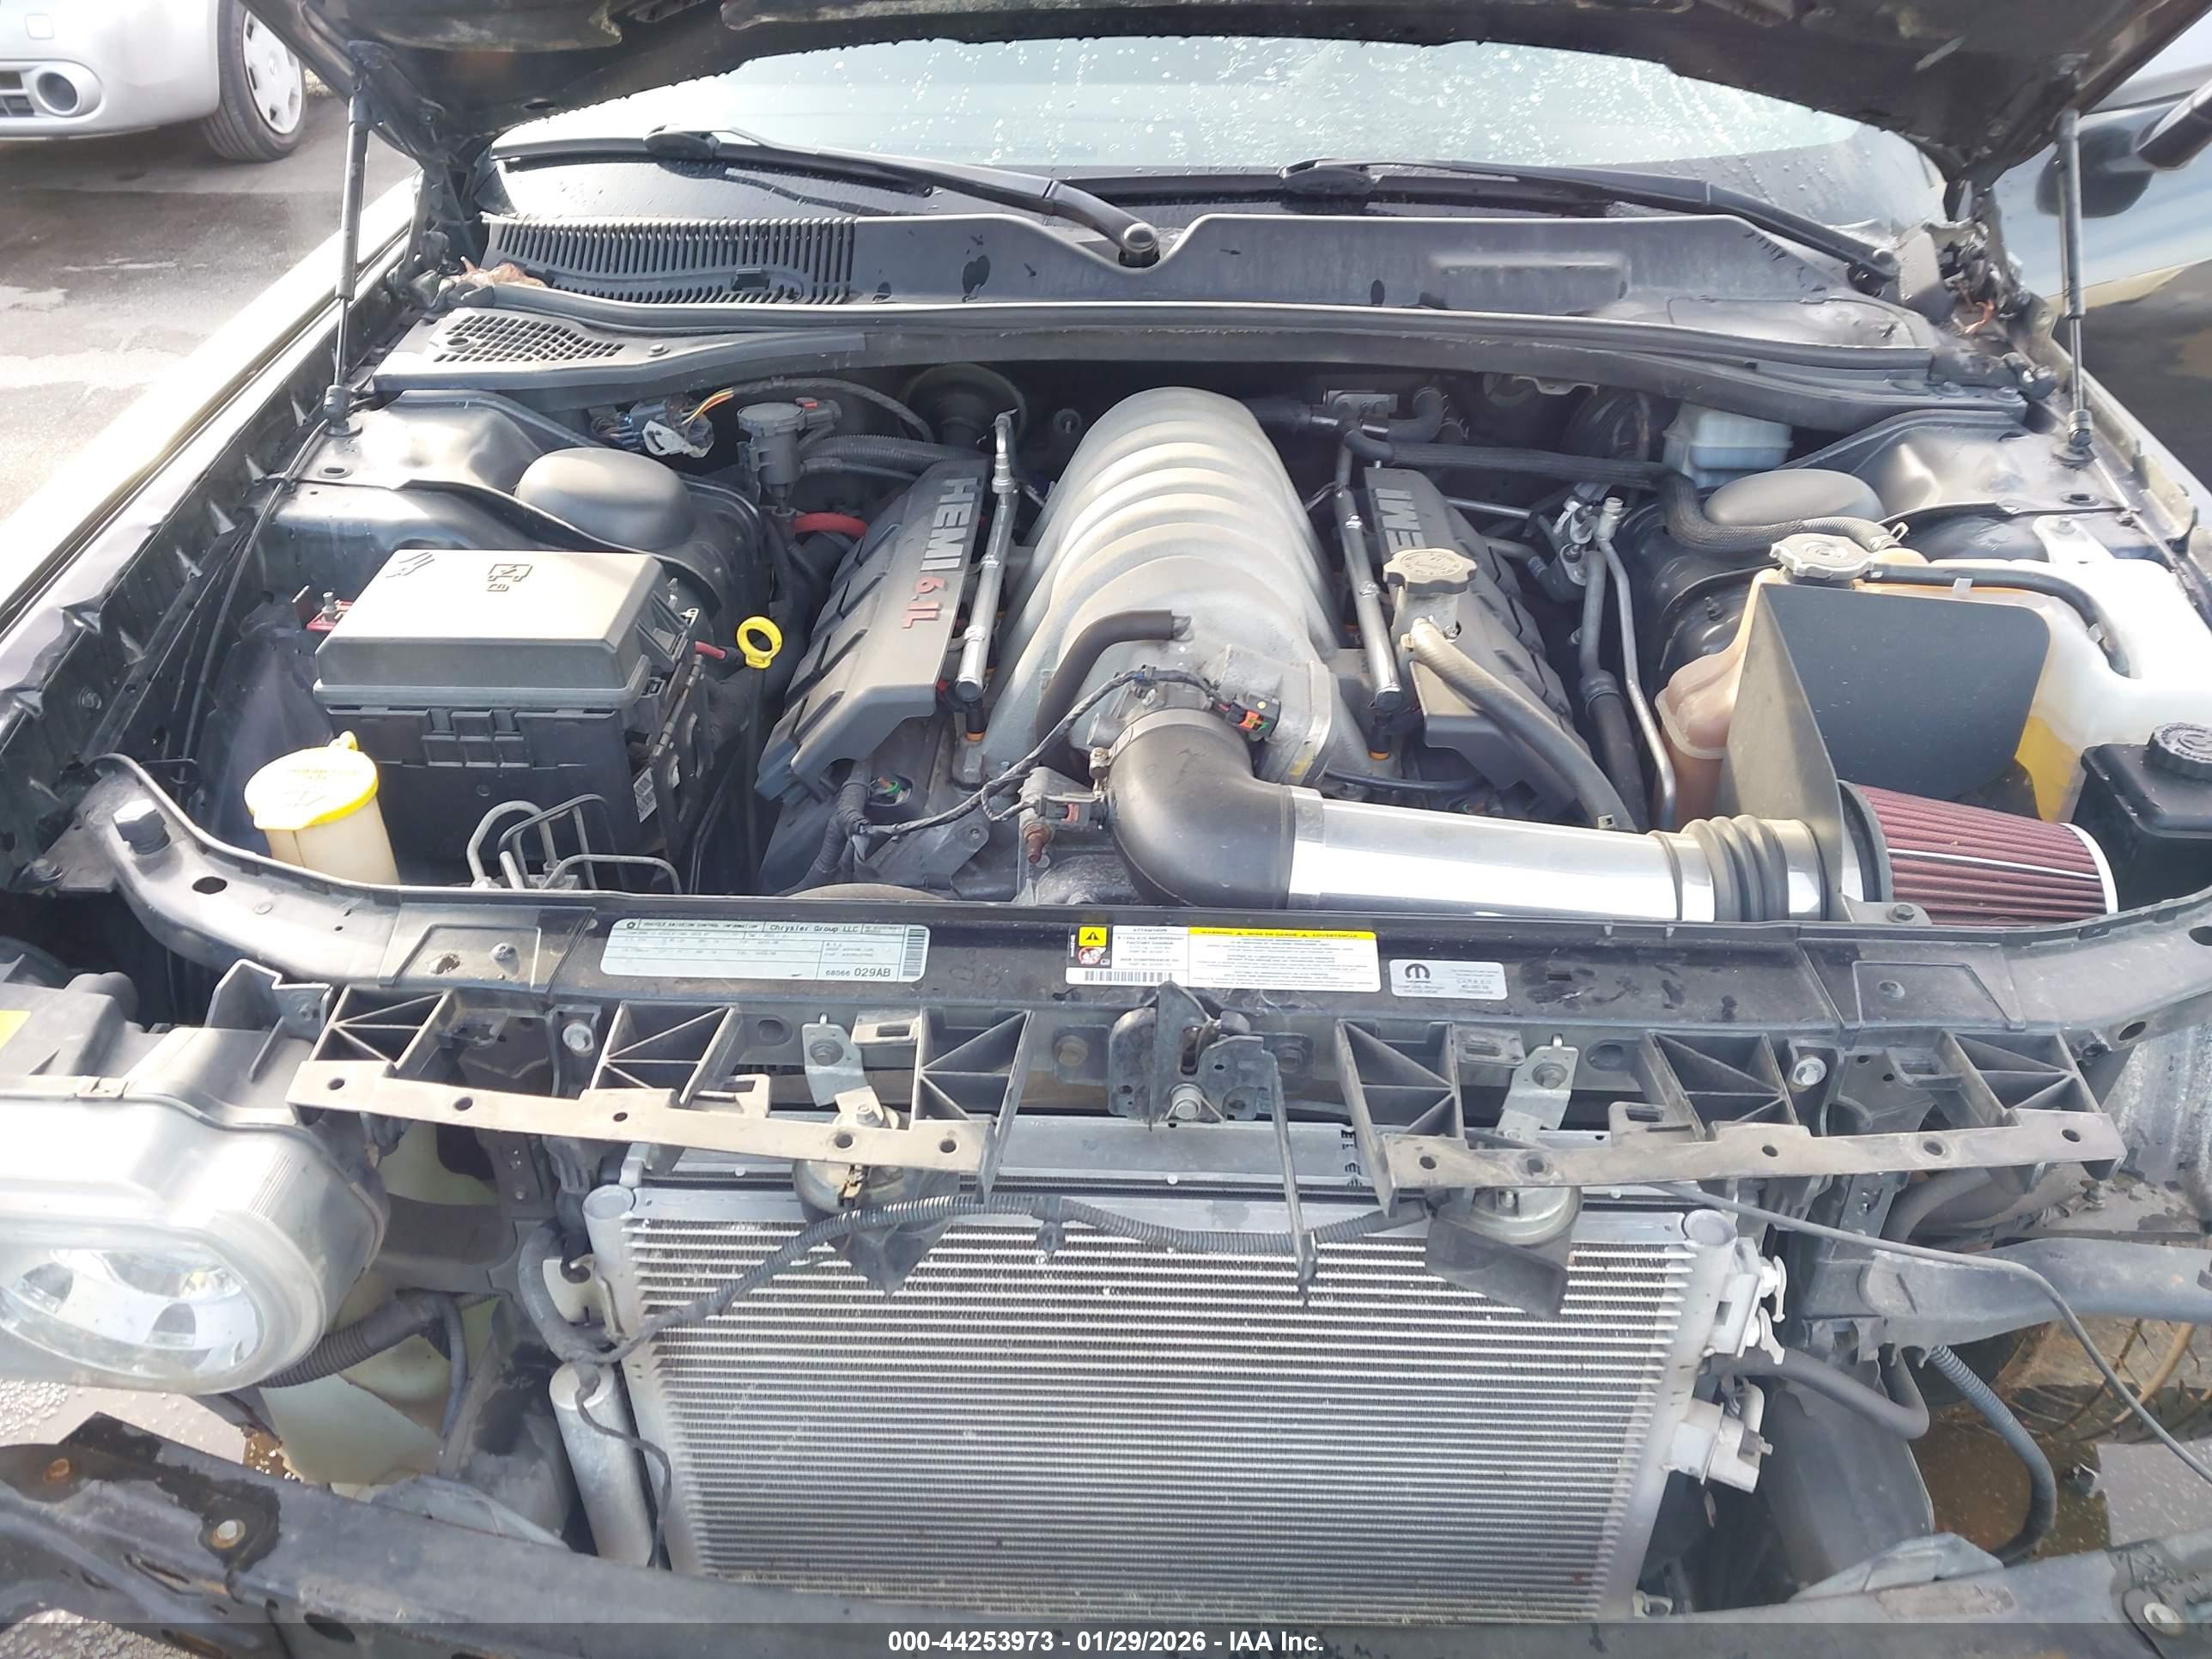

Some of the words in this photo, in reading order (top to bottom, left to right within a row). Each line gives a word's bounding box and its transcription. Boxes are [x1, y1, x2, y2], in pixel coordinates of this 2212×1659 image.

[921, 477, 978, 571] HEMI
[1375, 488, 1426, 554] EMI
[902, 576, 947, 629] 6.1L
[769, 924, 809, 933] Chrysler
[854, 968, 890, 977] 029AB
